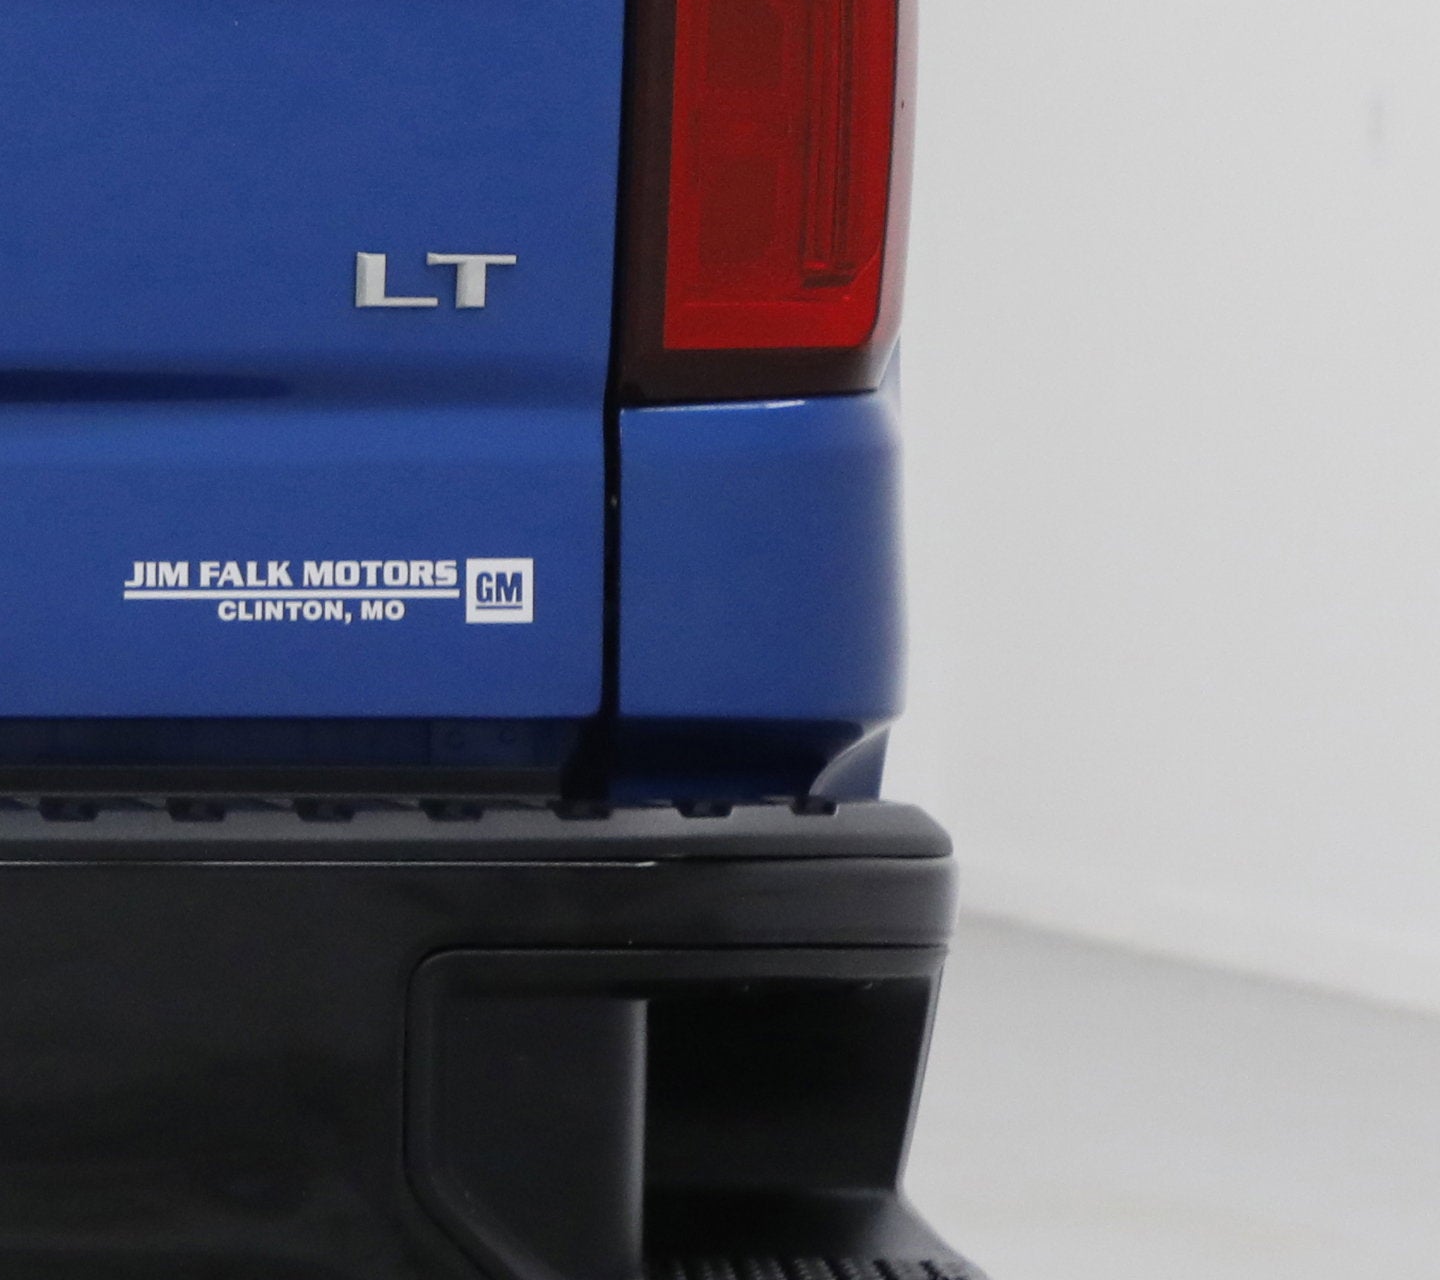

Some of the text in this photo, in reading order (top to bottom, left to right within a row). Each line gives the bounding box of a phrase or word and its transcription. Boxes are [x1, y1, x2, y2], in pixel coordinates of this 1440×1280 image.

[355, 251, 518, 308] LT
[123, 559, 458, 588] JIM FALK MOTORS
[475, 571, 523, 603] GM
[217, 599, 405, 624] CLINTON, MO
